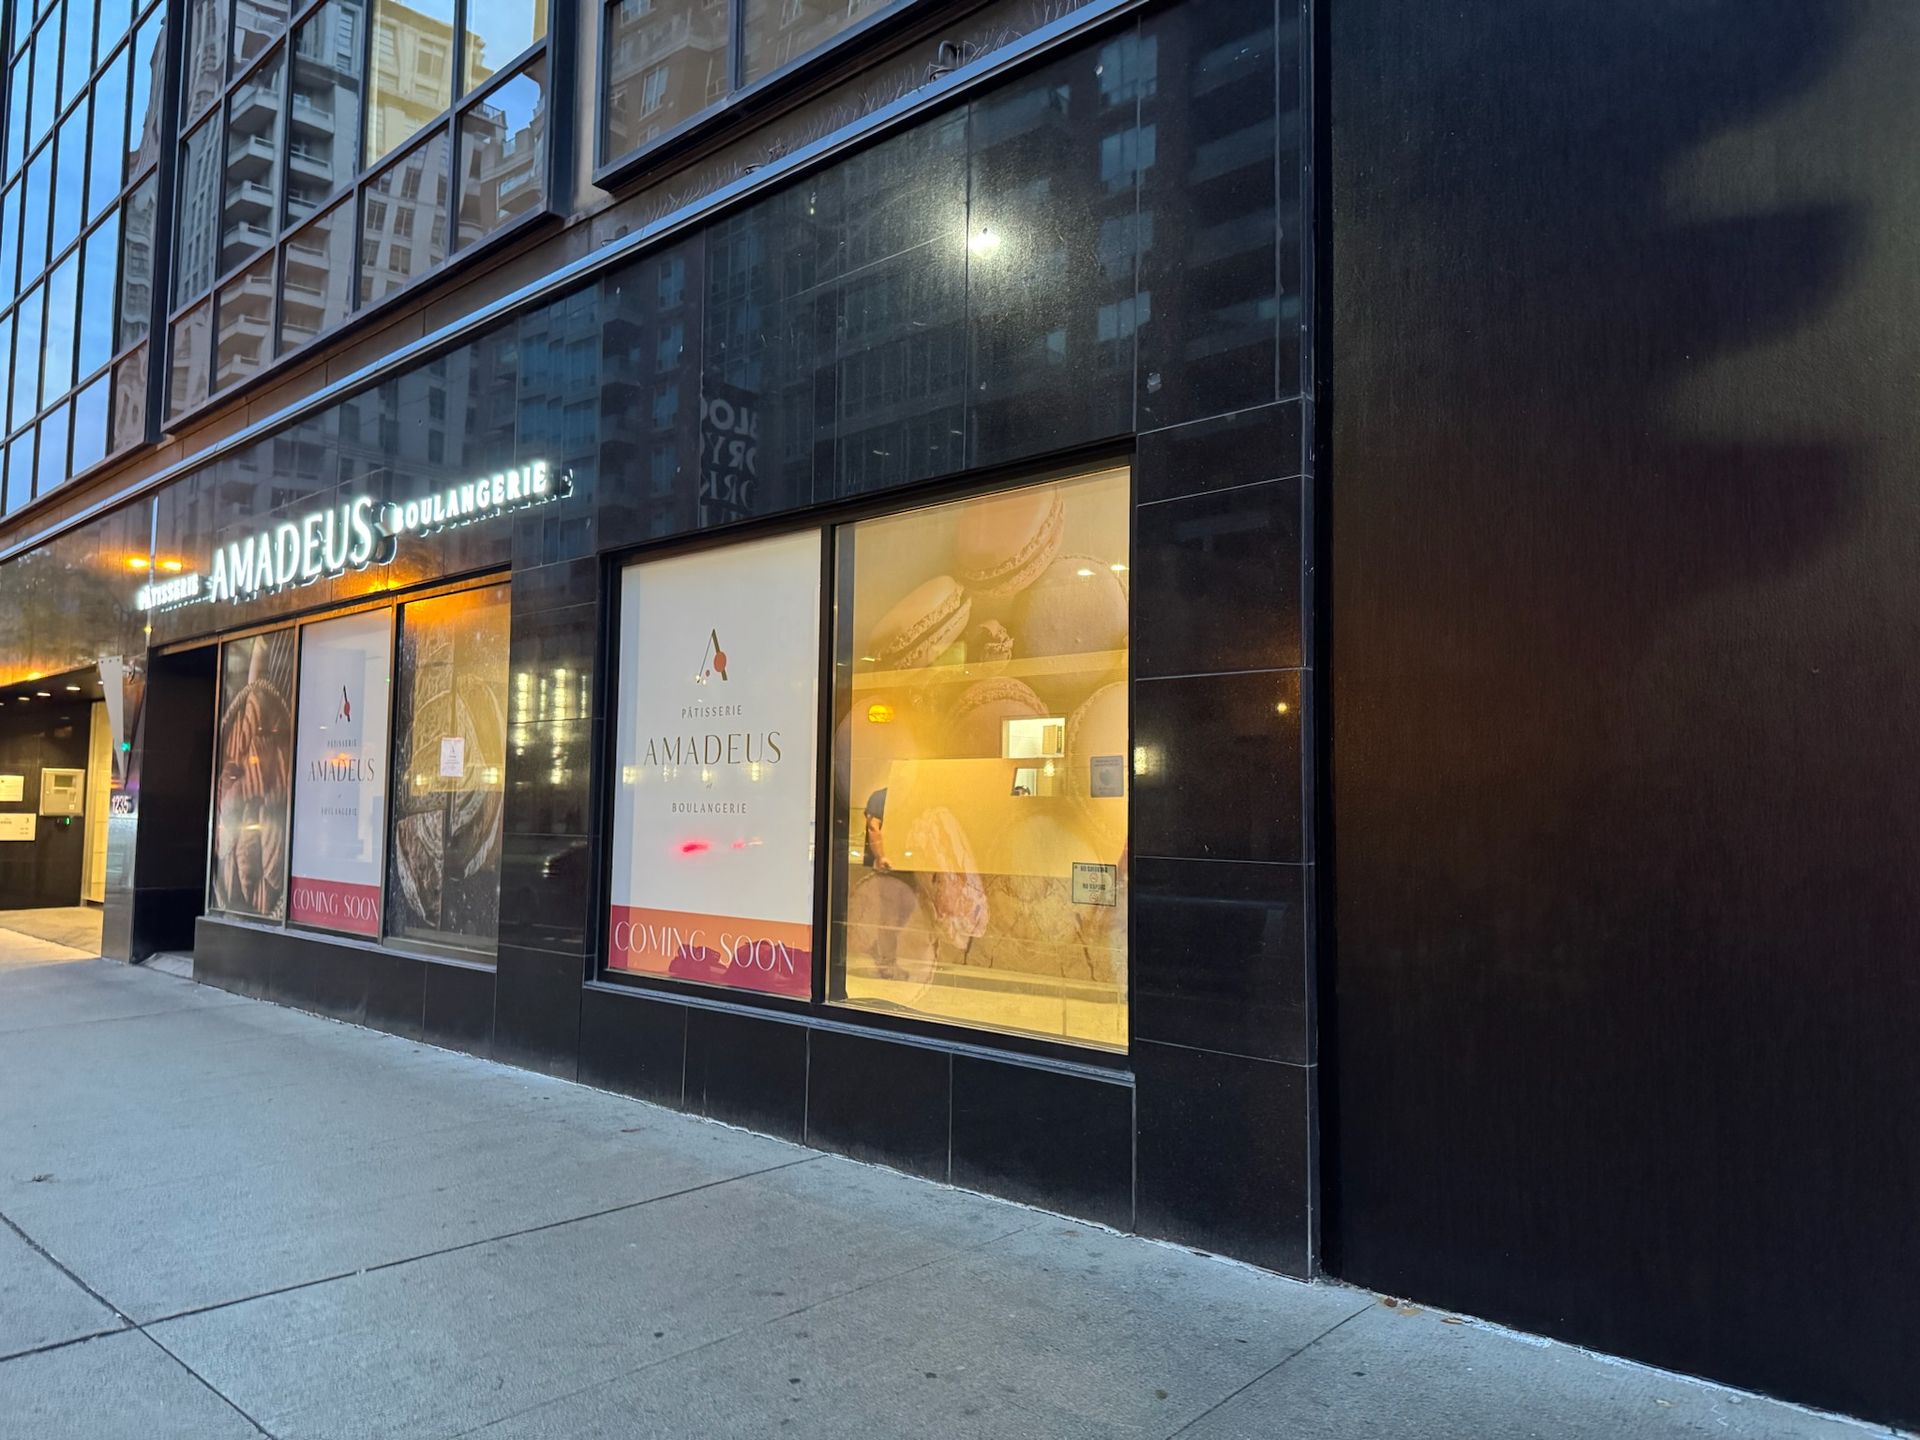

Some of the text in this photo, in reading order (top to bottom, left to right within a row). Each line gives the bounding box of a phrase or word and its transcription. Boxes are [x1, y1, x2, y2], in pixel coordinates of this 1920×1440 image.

[209, 496, 372, 603] AMADEUS
[393, 461, 547, 534] BOULANGERIE
[681, 704, 743, 719] PÂTISSERIE
[643, 731, 782, 766] AMADEUS
[307, 758, 375, 782] AMADEUS
[671, 802, 747, 815] BOULANGERIE
[292, 887, 379, 921] COMING SOON
[614, 921, 796, 975] COMING SOON
